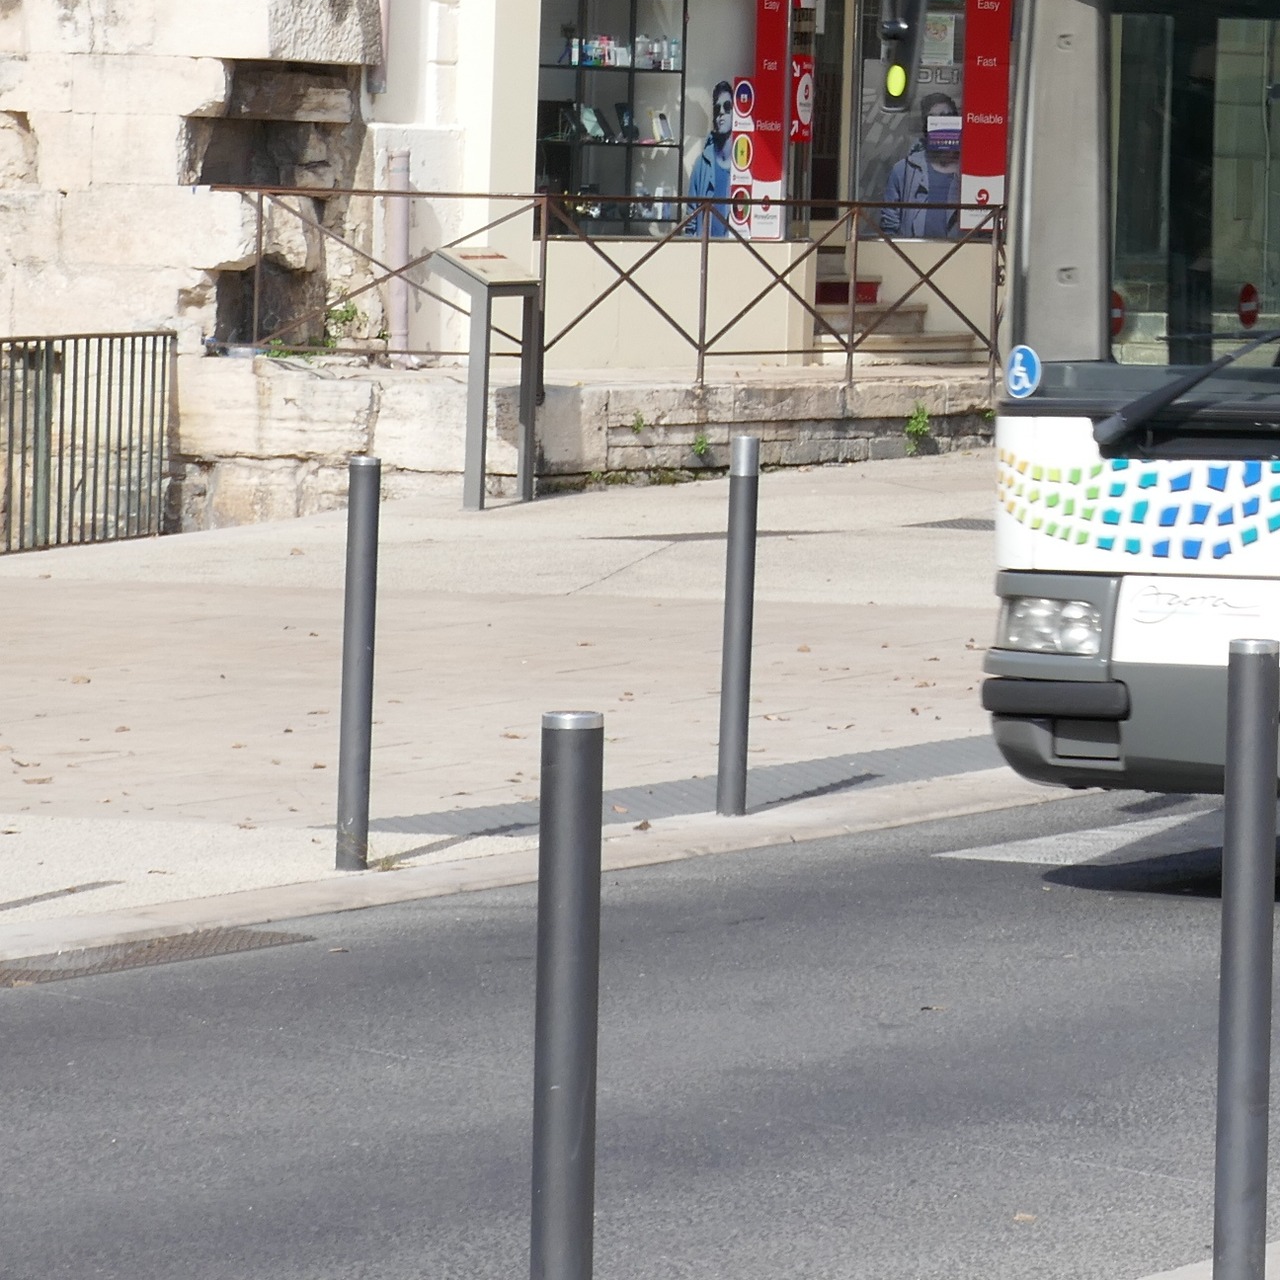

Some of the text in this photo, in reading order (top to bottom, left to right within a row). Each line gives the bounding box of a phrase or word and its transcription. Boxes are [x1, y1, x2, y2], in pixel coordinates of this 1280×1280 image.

[763, 59, 777, 71] Fast
[976, 55, 997, 67] Fast
[966, 113, 1003, 125] Reliable
[756, 120, 781, 131] Reliable
